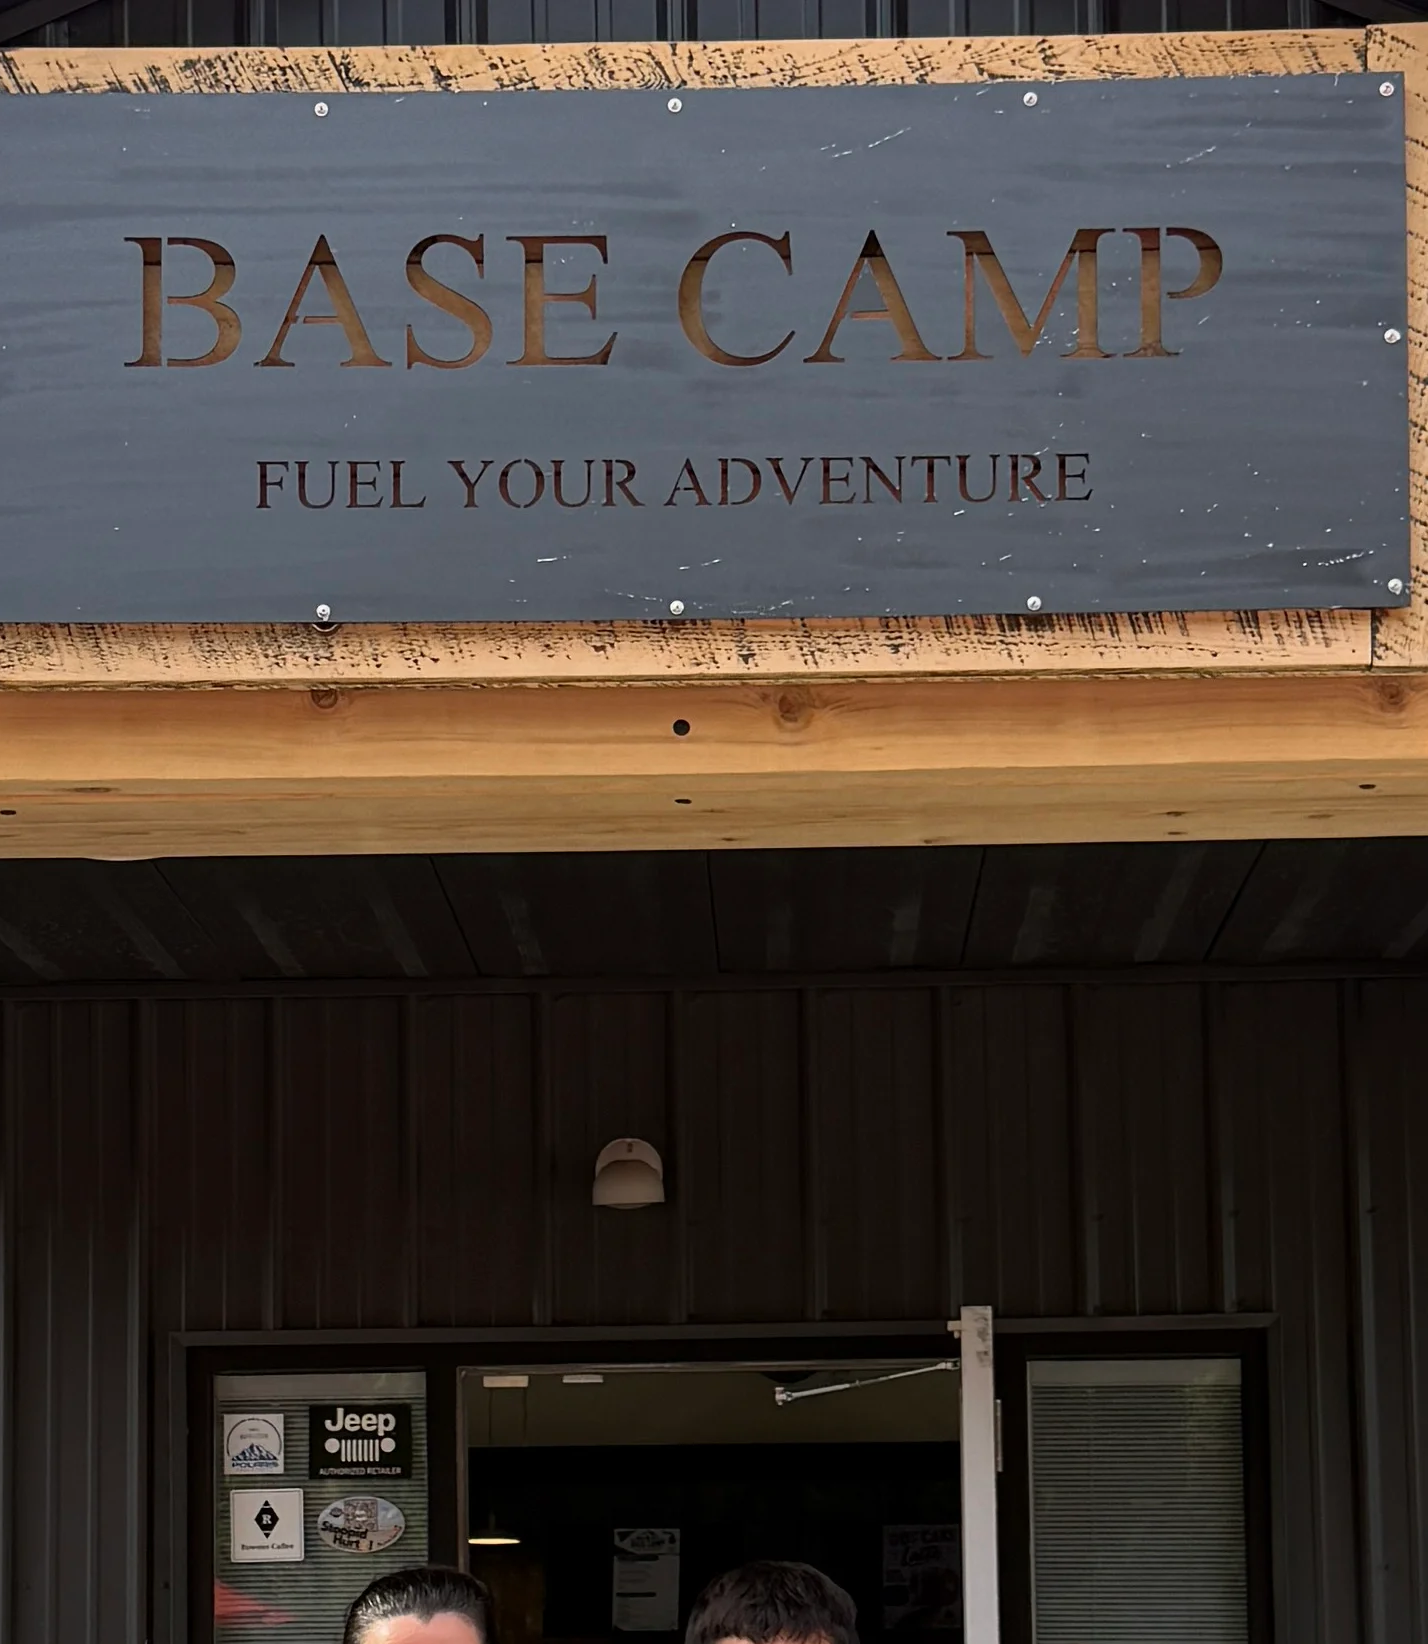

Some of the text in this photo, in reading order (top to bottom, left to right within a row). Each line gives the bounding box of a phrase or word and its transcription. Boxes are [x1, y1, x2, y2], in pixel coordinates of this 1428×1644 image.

[123, 226, 1224, 370] BASE CAMP
[255, 452, 1094, 510] FUEL YOUR ADVENTURE
[324, 1407, 396, 1437] Jeep
[319, 1466, 402, 1476] AUTHORIZED RETAILER
[261, 1514, 272, 1525] R
